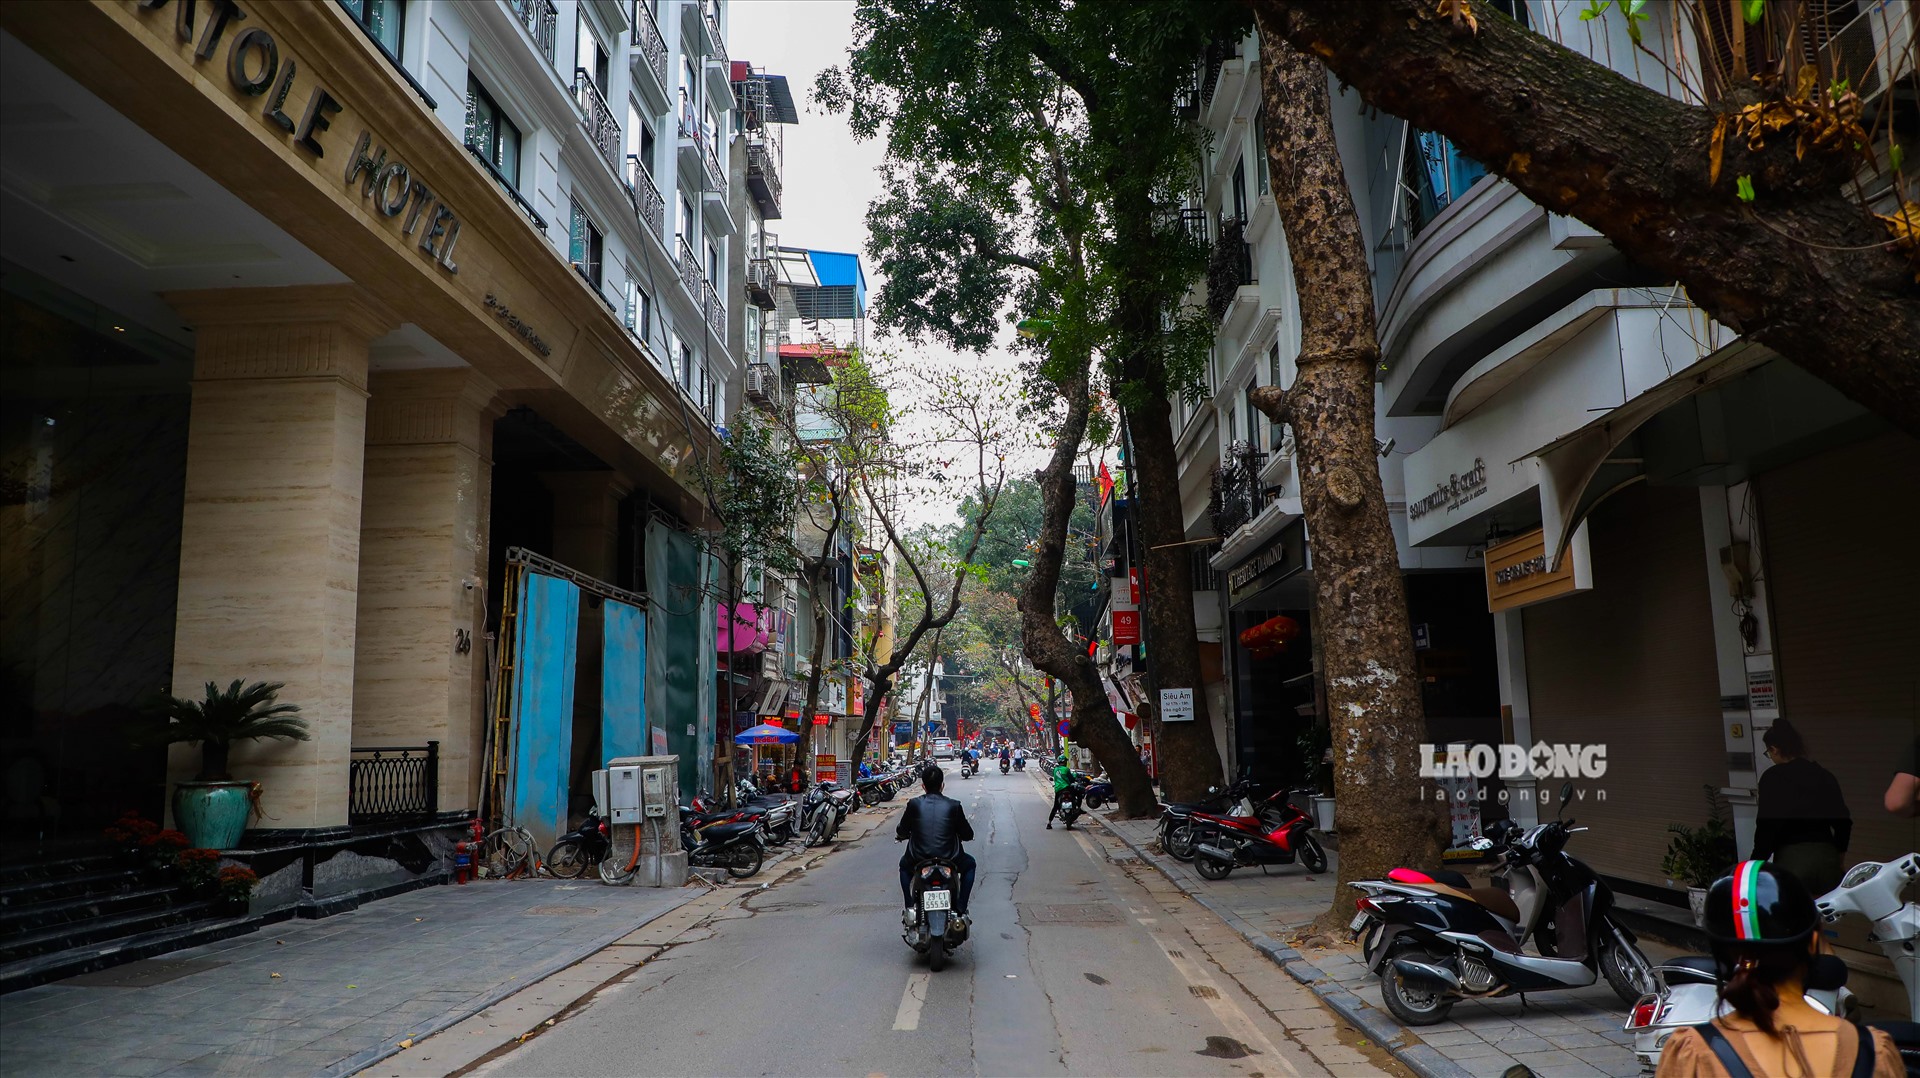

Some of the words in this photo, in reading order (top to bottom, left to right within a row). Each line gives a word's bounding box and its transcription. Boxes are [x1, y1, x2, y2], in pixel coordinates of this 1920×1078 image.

[345, 129, 463, 275] HOTEL
[1409, 484, 1450, 519] souvenirs
[1450, 473, 1461, 497] &
[1461, 457, 1486, 491] craft
[1257, 542, 1283, 575] DIAMOND
[1120, 616, 1131, 625] 49
[453, 628, 471, 656] 26
[1163, 692, 1178, 700] Siêu
[1179, 690, 1191, 699] Âm
